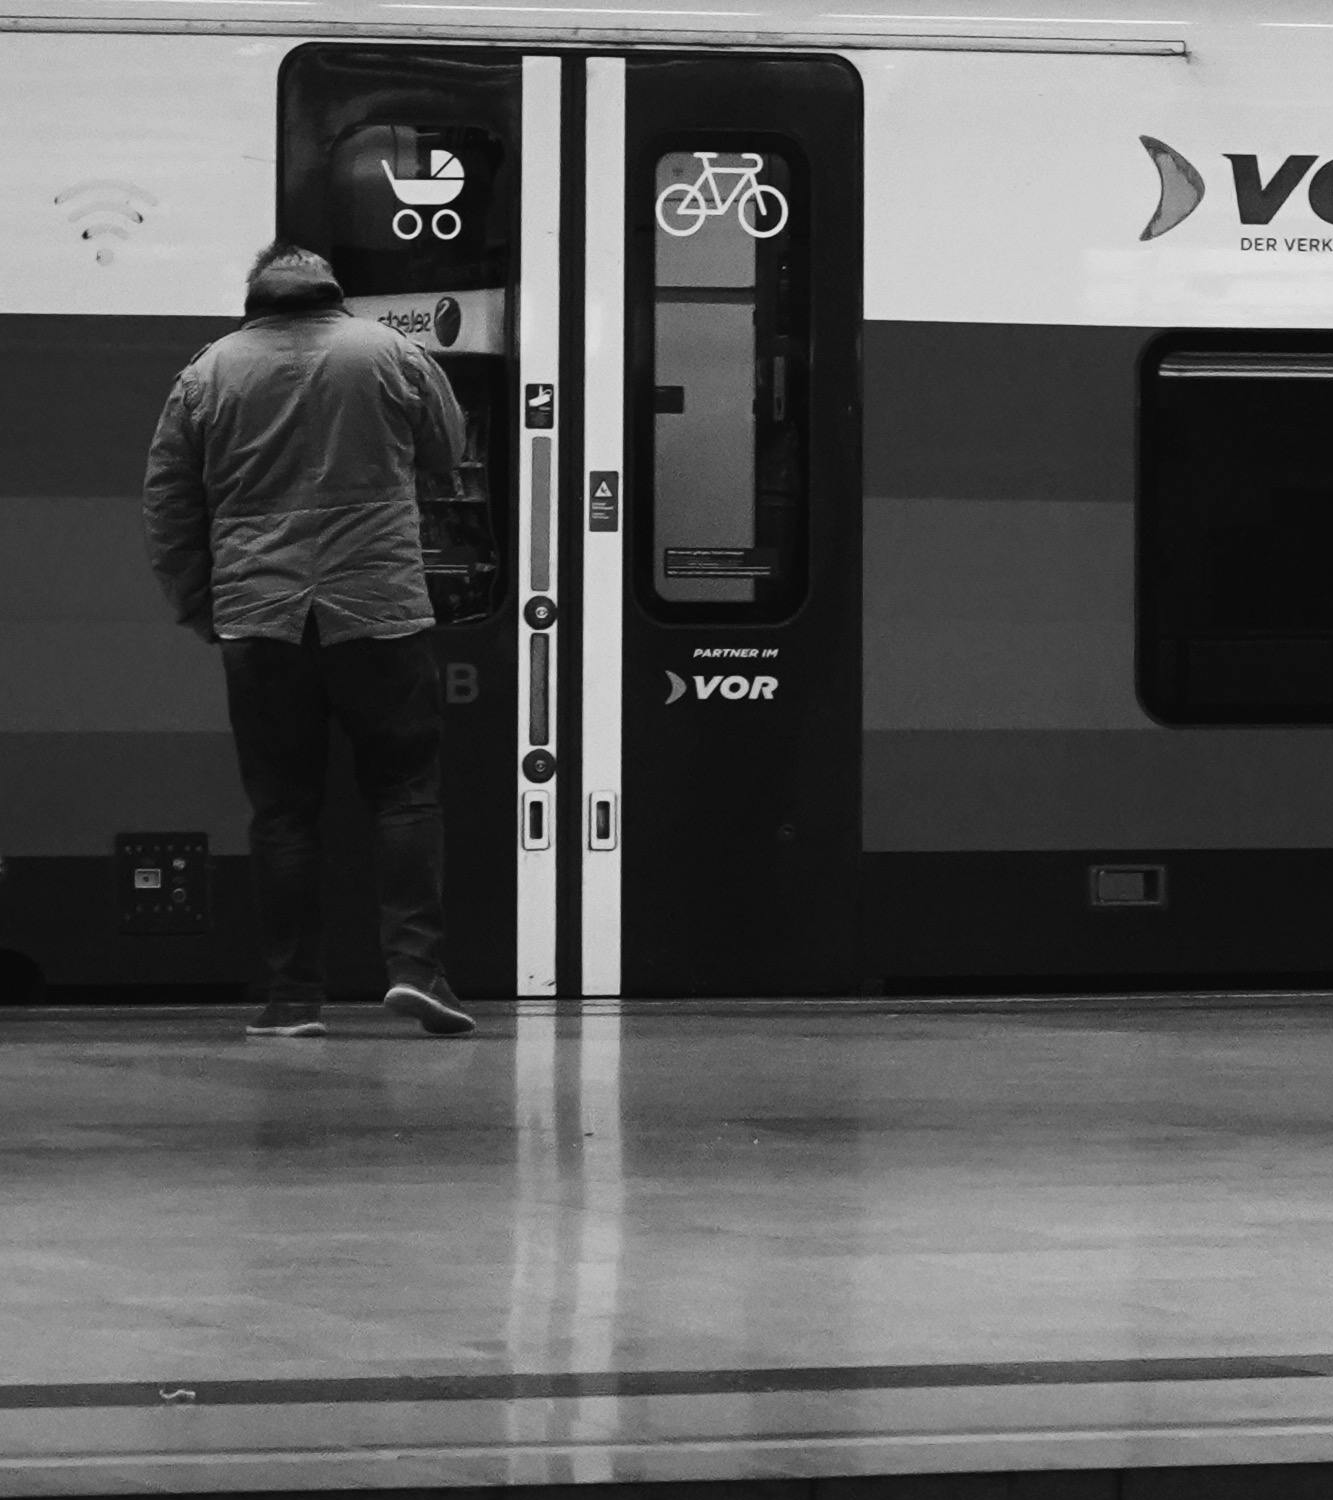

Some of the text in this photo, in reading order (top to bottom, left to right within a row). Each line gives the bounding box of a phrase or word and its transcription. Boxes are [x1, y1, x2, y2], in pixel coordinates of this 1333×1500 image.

[1240, 237, 1278, 251] DER
[693, 648, 779, 658] PARTNER IM
[692, 675, 779, 700] VOR
